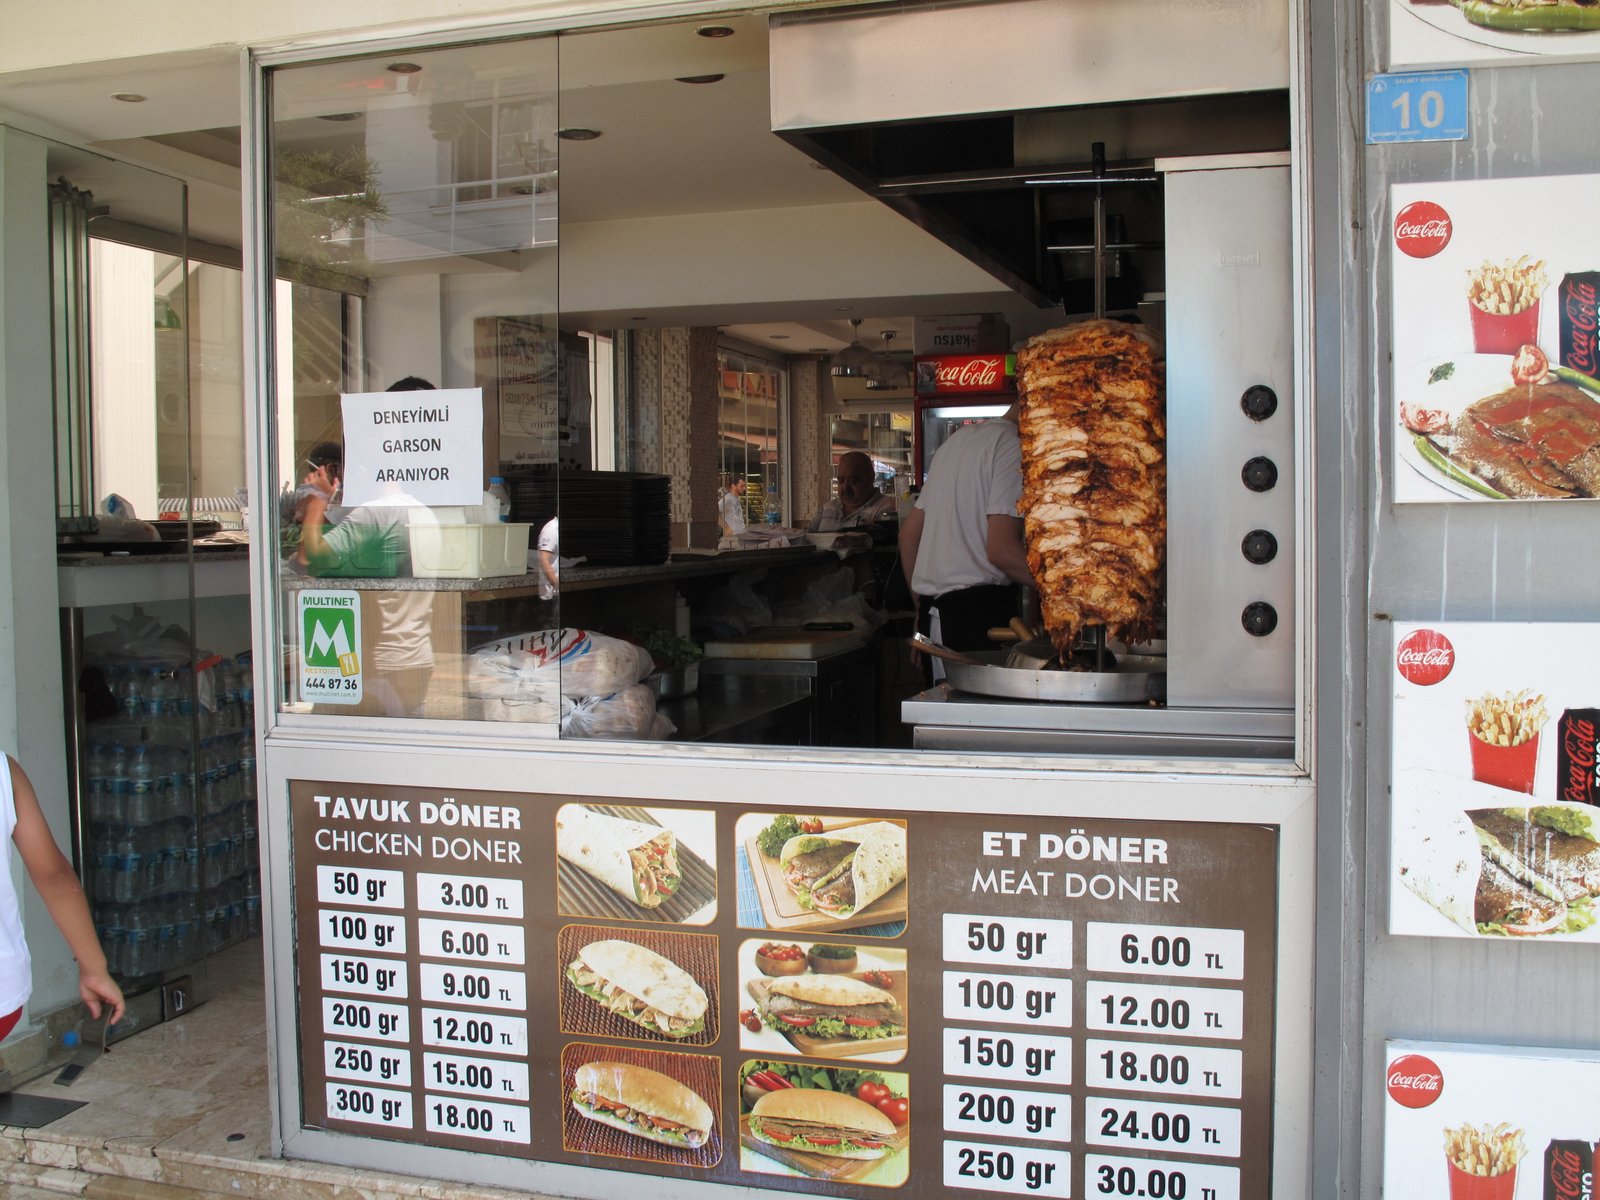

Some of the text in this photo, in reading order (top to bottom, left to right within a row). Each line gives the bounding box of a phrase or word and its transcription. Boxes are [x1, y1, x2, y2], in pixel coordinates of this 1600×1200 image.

[1391, 90, 1445, 129] 10
[1397, 219, 1448, 239] Coca-Cola
[1566, 280, 1597, 376] Coca-Cola
[935, 359, 1000, 387] oca-Cola
[373, 405, 449, 425] DENEYİMLİ
[383, 438, 441, 453] GARSON
[376, 467, 450, 482] ARANIYOR
[303, 596, 355, 607] MULTINET
[1399, 648, 1453, 666] Coca-Cola
[305, 677, 358, 690] 444 87 36
[313, 795, 521, 830] TAVUK DÖNER
[315, 829, 523, 864] CHICKEN DONER
[982, 828, 1169, 864] ET DÖNER
[334, 872, 387, 902] 50 gr
[441, 882, 509, 910] 3.00 TL
[971, 867, 1181, 903] MEAT DONER
[329, 915, 395, 947] 100 gr
[441, 930, 510, 957] 6.00 TL
[967, 922, 1047, 960] 50 gr
[1120, 934, 1224, 970] 6.00 TL
[330, 959, 397, 991] 150 gr
[442, 972, 512, 1001] 9.00 TL
[958, 978, 1056, 1019] 100 gr
[1100, 995, 1223, 1030] 12.00 TL
[332, 1003, 399, 1035] 200 gr
[432, 1016, 513, 1045] 12.00 TL
[334, 1046, 401, 1079] 250 gr
[958, 1036, 1056, 1076] 150 gr
[1100, 1050, 1222, 1087] 18.00 TL
[432, 1060, 515, 1092] 15.00 TL
[1389, 1071, 1441, 1091] Coca-Cola
[335, 1088, 402, 1122] 300 gr
[433, 1103, 516, 1133] 18.00 TL
[958, 1092, 1056, 1133] 200 gr
[1099, 1108, 1221, 1144] 24.00 TL
[958, 1148, 1056, 1189] 250 gr
[1097, 1164, 1187, 1200] 30.00
